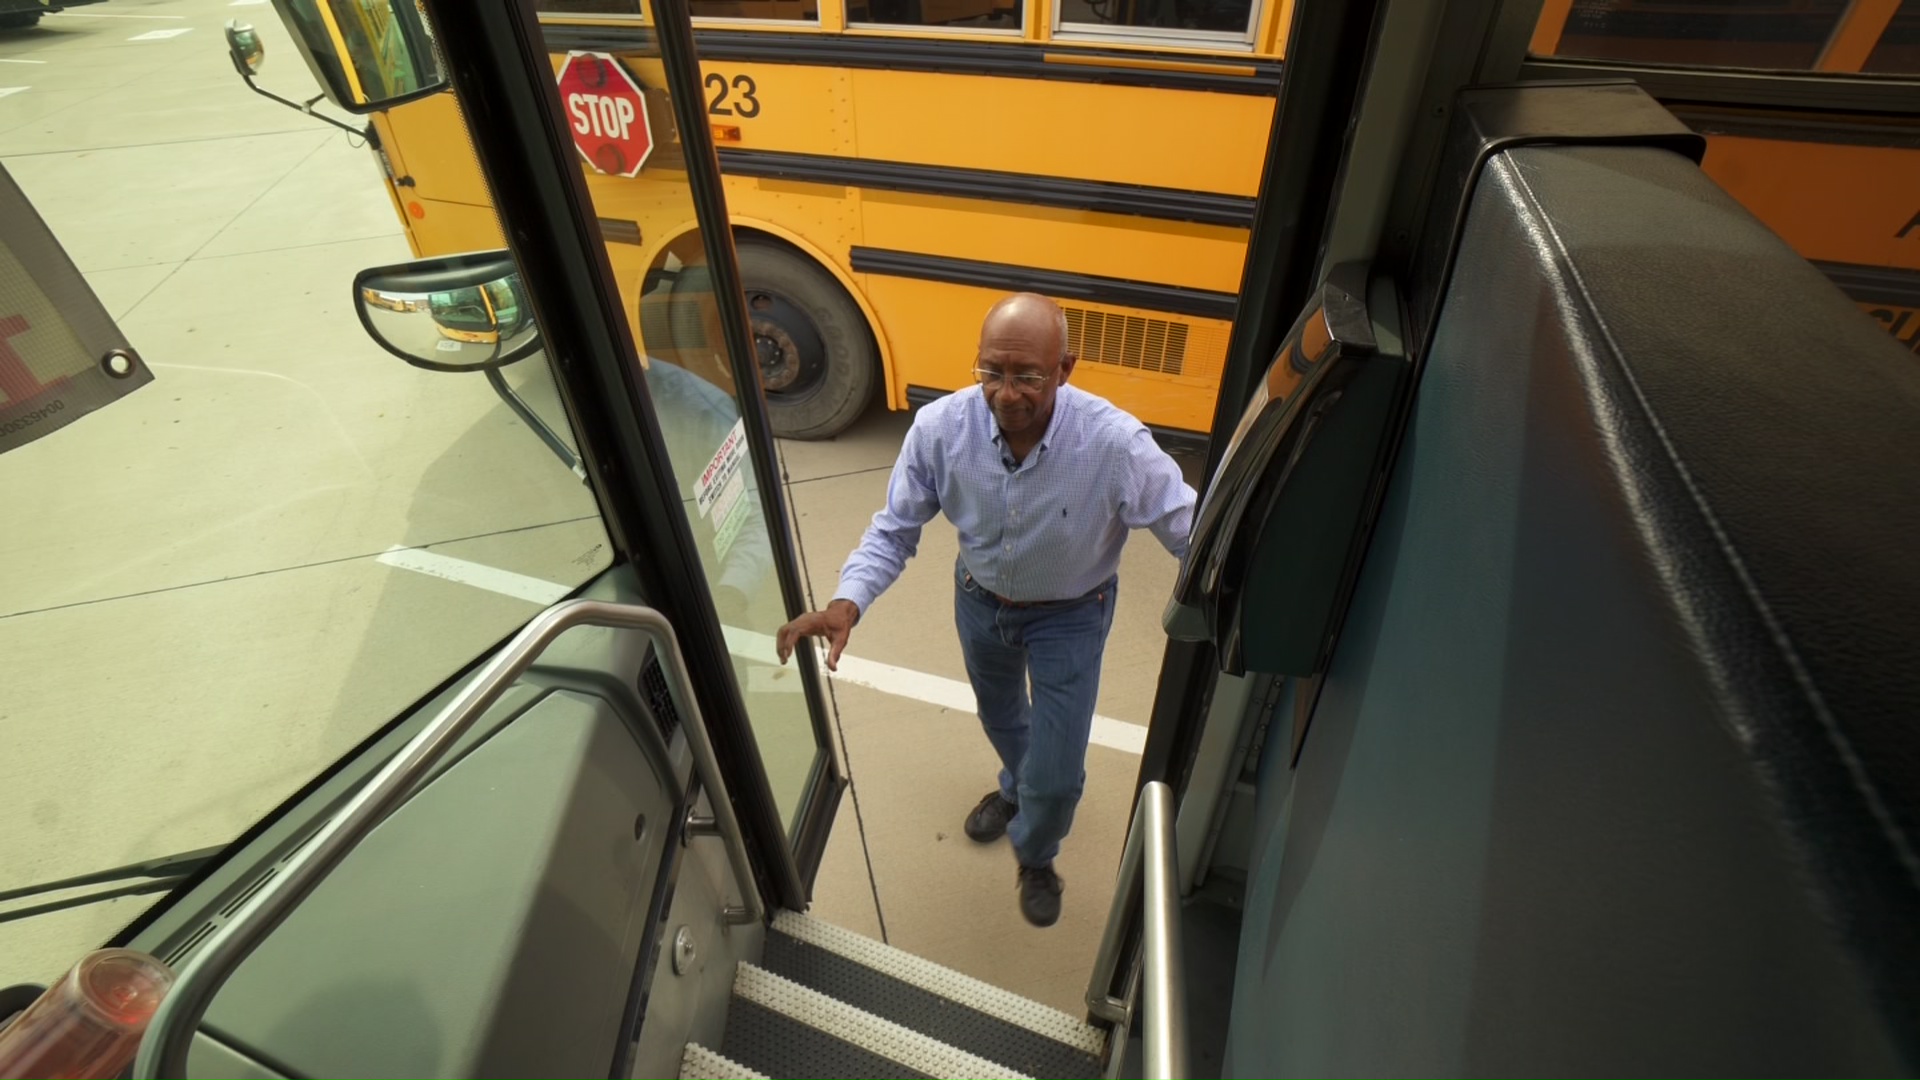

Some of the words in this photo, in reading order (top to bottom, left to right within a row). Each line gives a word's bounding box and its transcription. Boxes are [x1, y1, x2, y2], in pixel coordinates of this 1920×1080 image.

[568, 92, 635, 141] STOP
[704, 72, 761, 119] 23
[702, 428, 737, 487] IMPORTANT
